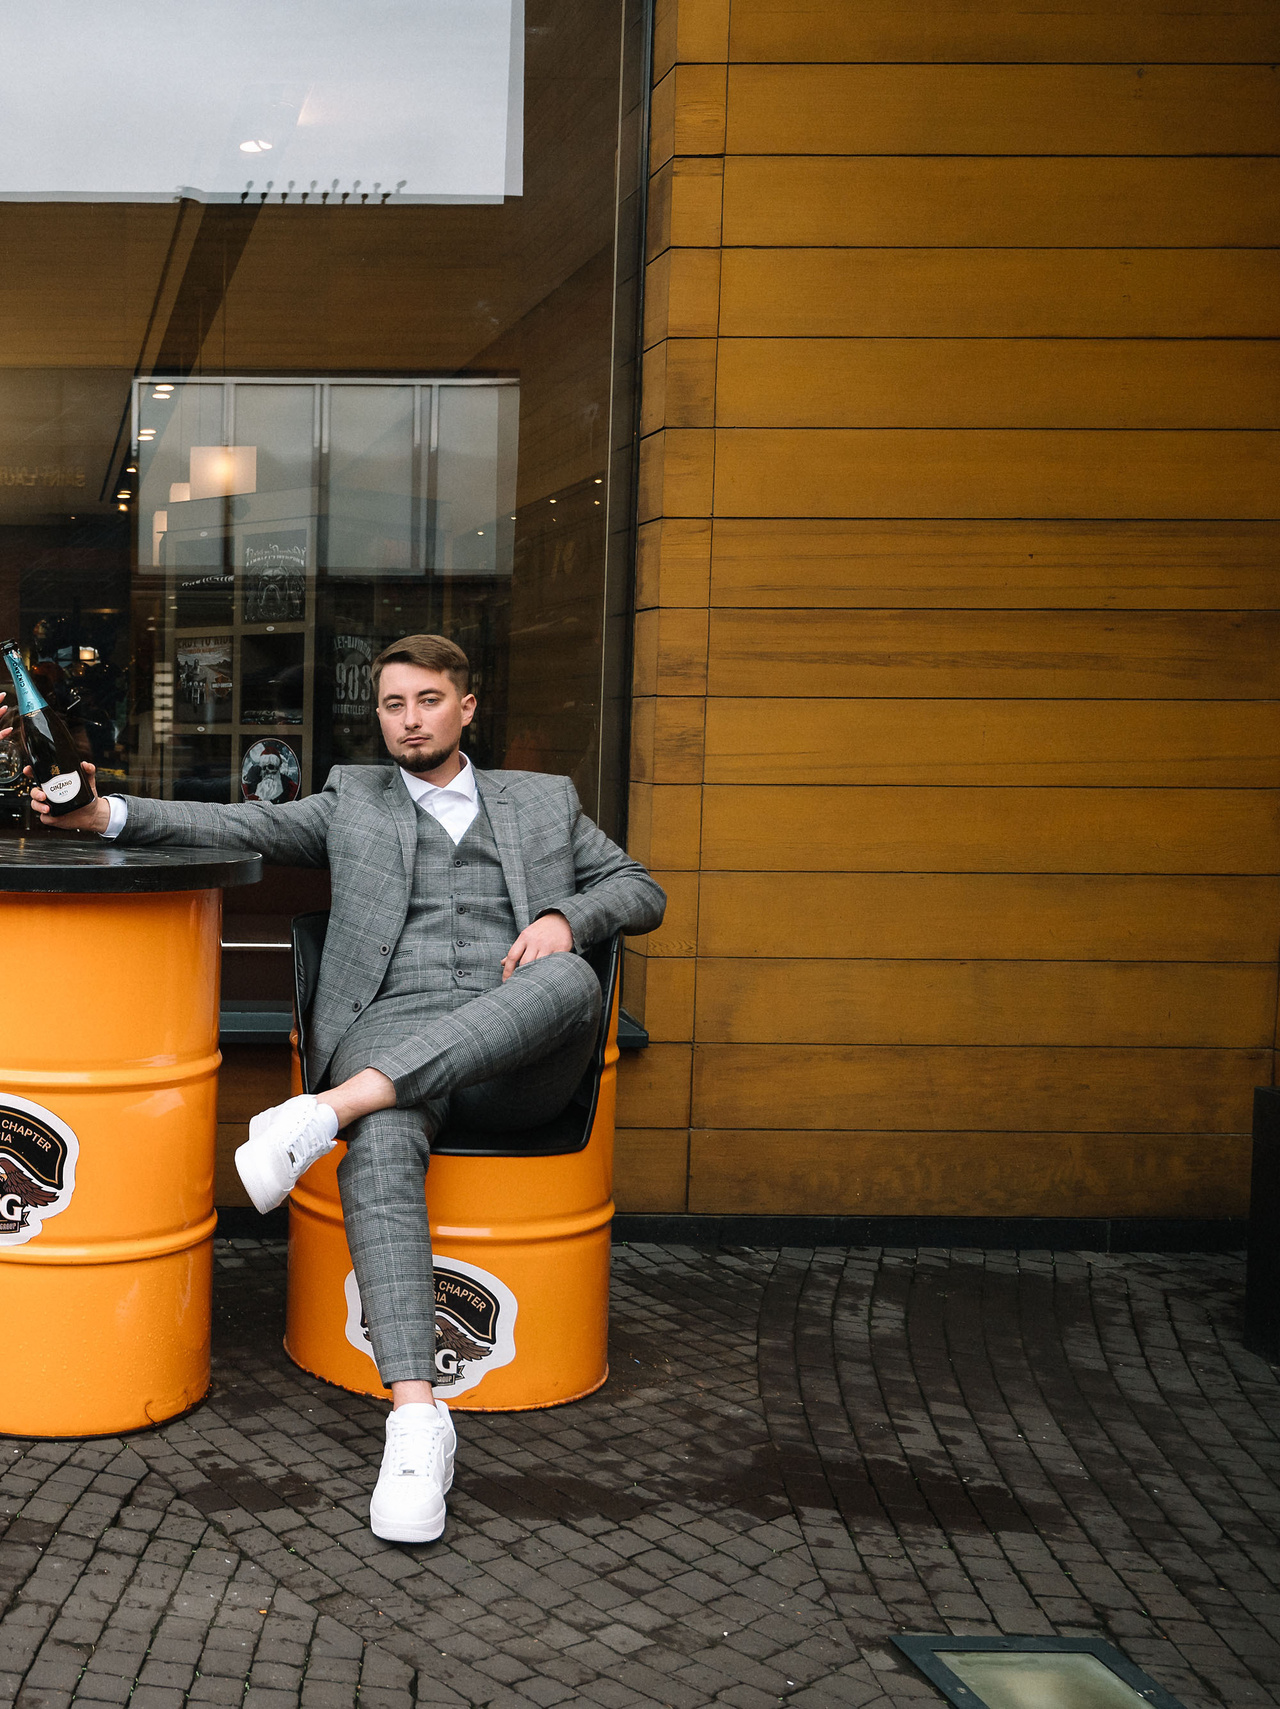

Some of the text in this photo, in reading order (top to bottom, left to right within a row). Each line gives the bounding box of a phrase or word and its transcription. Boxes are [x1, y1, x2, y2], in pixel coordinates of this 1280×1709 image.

[50, 780, 73, 792] CINZANO
[2, 1119, 51, 1152] CHAPTER
[0, 1222, 17, 1231] GROUP
[438, 1280, 487, 1313] CHAPTER
